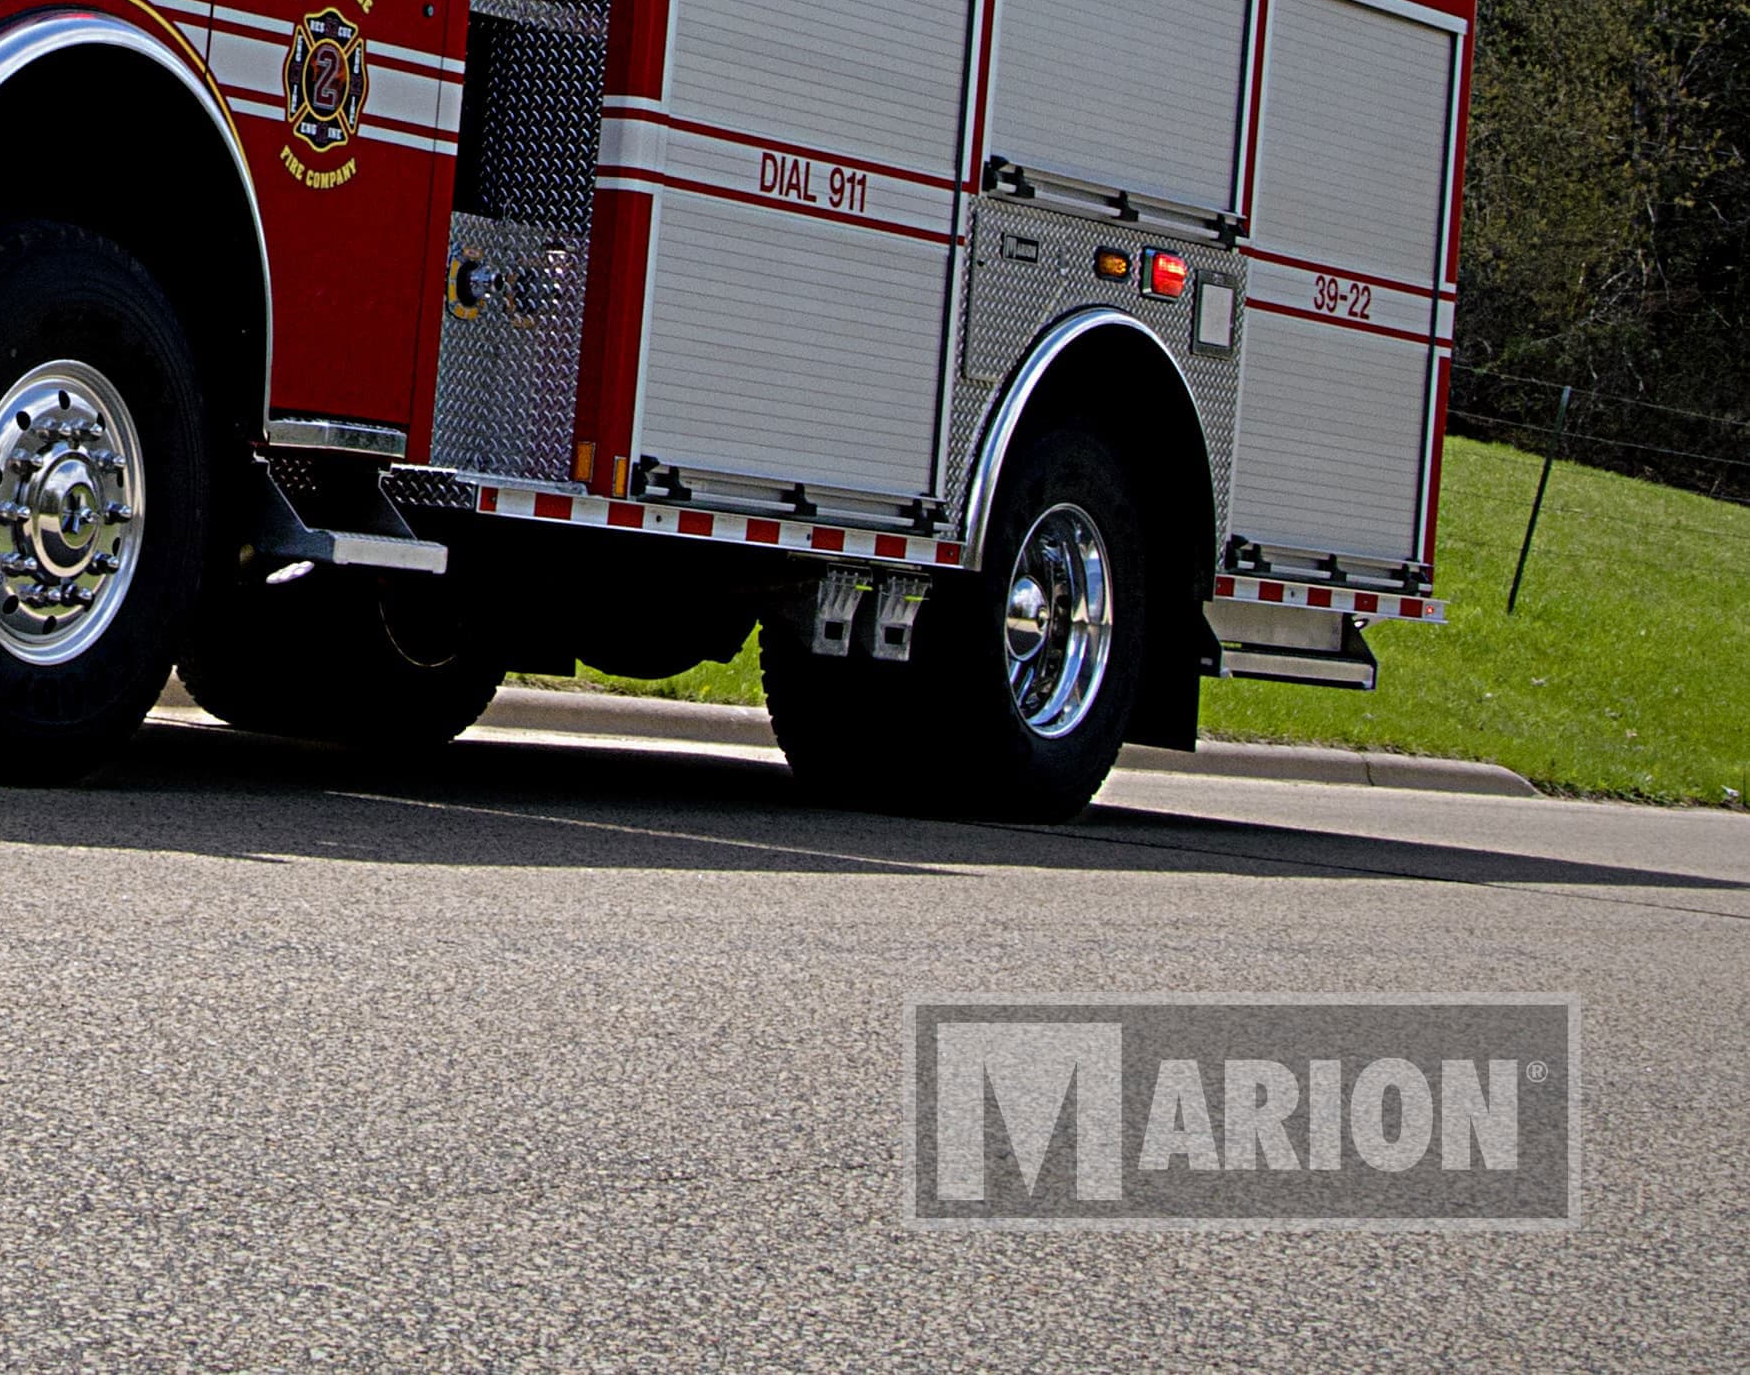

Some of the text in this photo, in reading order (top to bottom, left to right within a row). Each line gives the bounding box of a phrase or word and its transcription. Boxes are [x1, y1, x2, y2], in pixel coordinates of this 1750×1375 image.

[312, 45, 340, 111] 2
[280, 145, 356, 189] FIRE COMPANY
[760, 152, 867, 213] DIAL 911
[1314, 275, 1371, 320] 39-22
